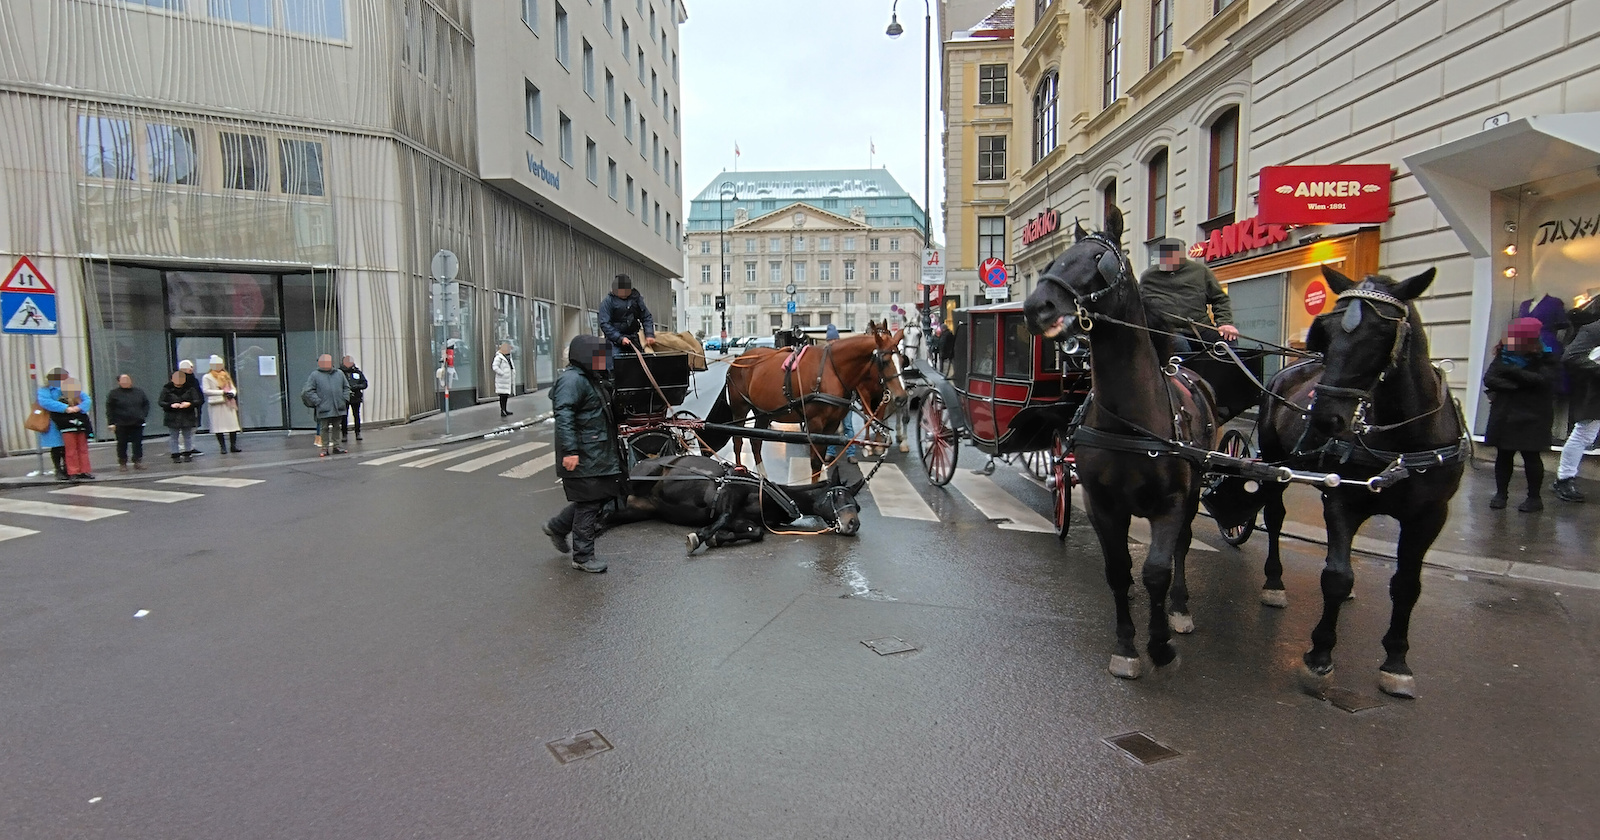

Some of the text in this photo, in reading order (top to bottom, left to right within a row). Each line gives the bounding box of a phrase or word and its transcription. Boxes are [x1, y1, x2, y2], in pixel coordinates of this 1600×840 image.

[526, 150, 560, 191] Verbund
[1294, 181, 1361, 197] ANKER
[1022, 207, 1059, 246] akakiko
[1205, 216, 1288, 262] ANKER
